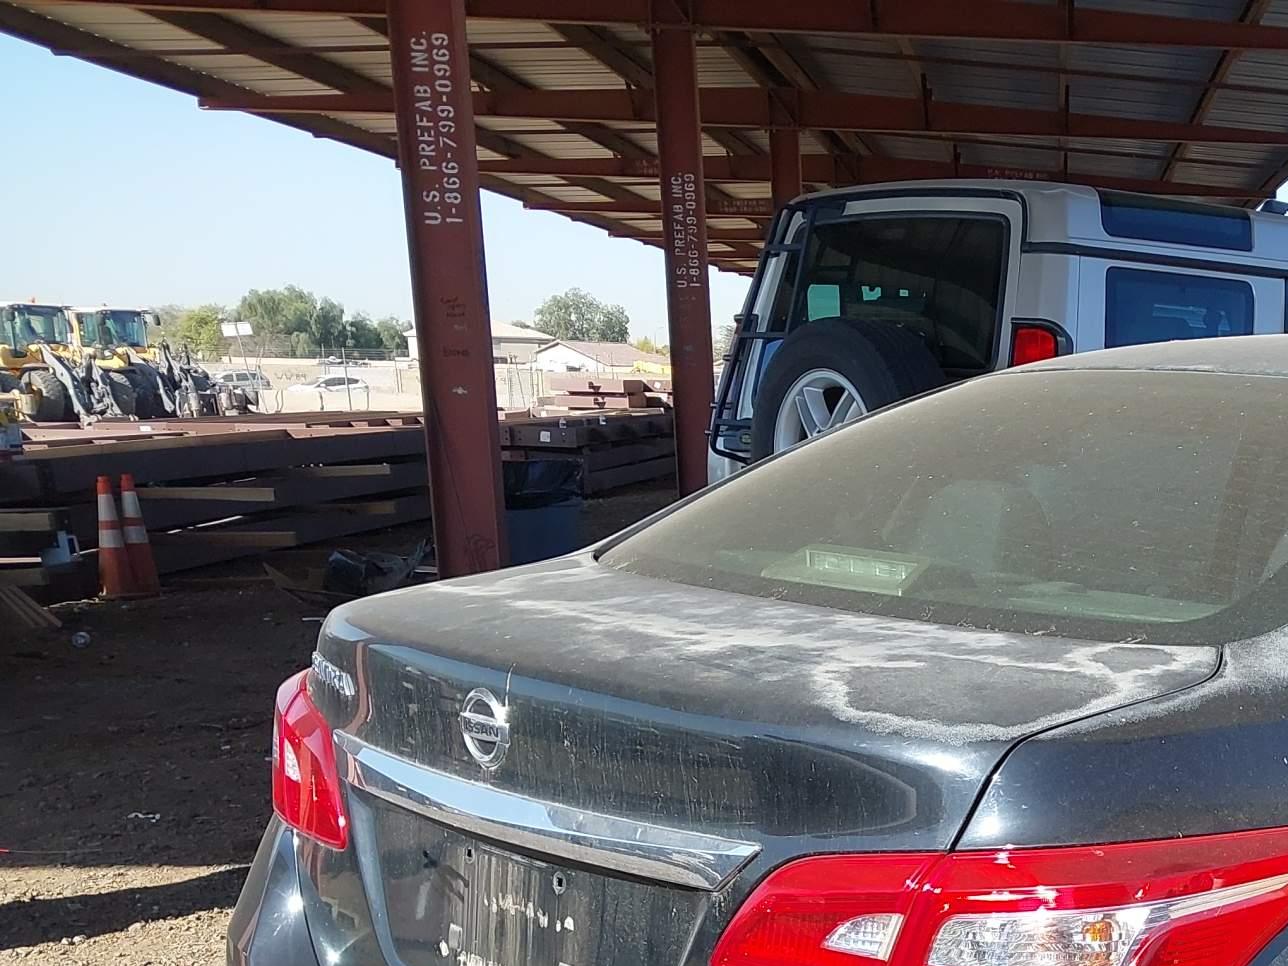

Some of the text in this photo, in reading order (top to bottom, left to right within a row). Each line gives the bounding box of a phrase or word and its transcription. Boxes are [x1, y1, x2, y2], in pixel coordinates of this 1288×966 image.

[410, 31, 442, 225] U.S. PREFAB INC.
[431, 32, 464, 223] 1-866-799-0969
[671, 172, 688, 288] U.S. PREFAB INC.
